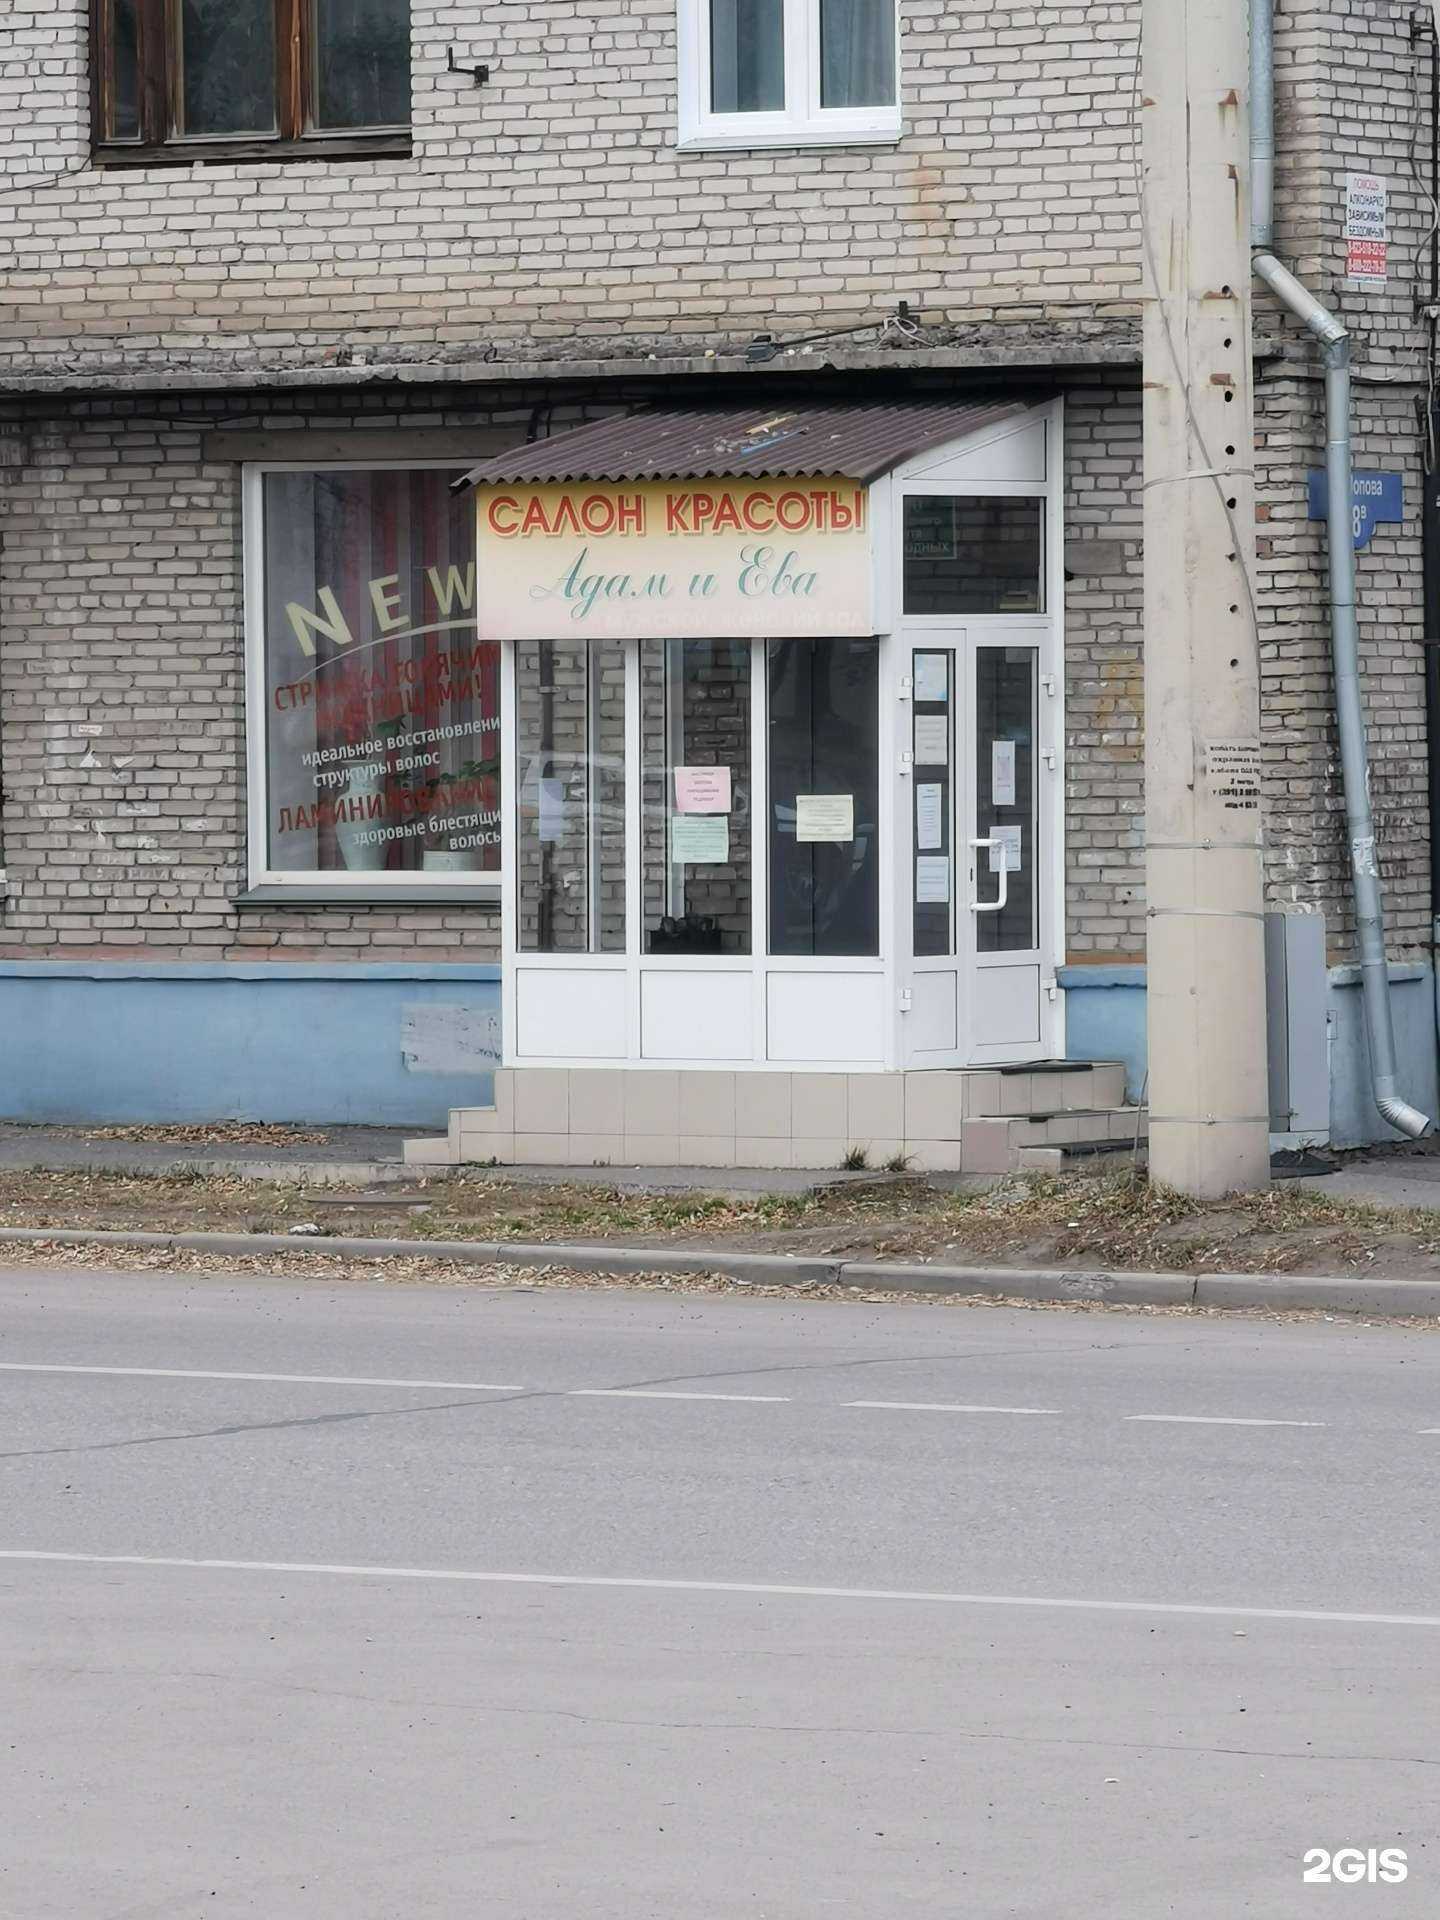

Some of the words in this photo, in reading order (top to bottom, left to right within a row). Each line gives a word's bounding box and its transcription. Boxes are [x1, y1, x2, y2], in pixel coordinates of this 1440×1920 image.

[1352, 478, 1383, 495] опова
[487, 494, 646, 536] САЛОН
[665, 490, 866, 533] КРАСОТЫ
[529, 546, 671, 621] Адам
[688, 572, 718, 598] и
[737, 544, 819, 598] Ева
[285, 562, 476, 657] NEW
[302, 738, 383, 766] идеальное
[387, 716, 501, 749] восстановлени
[313, 761, 391, 789] структуры
[396, 752, 440, 772] волос
[353, 821, 425, 846] здоровые
[429, 809, 501, 833] блестящи
